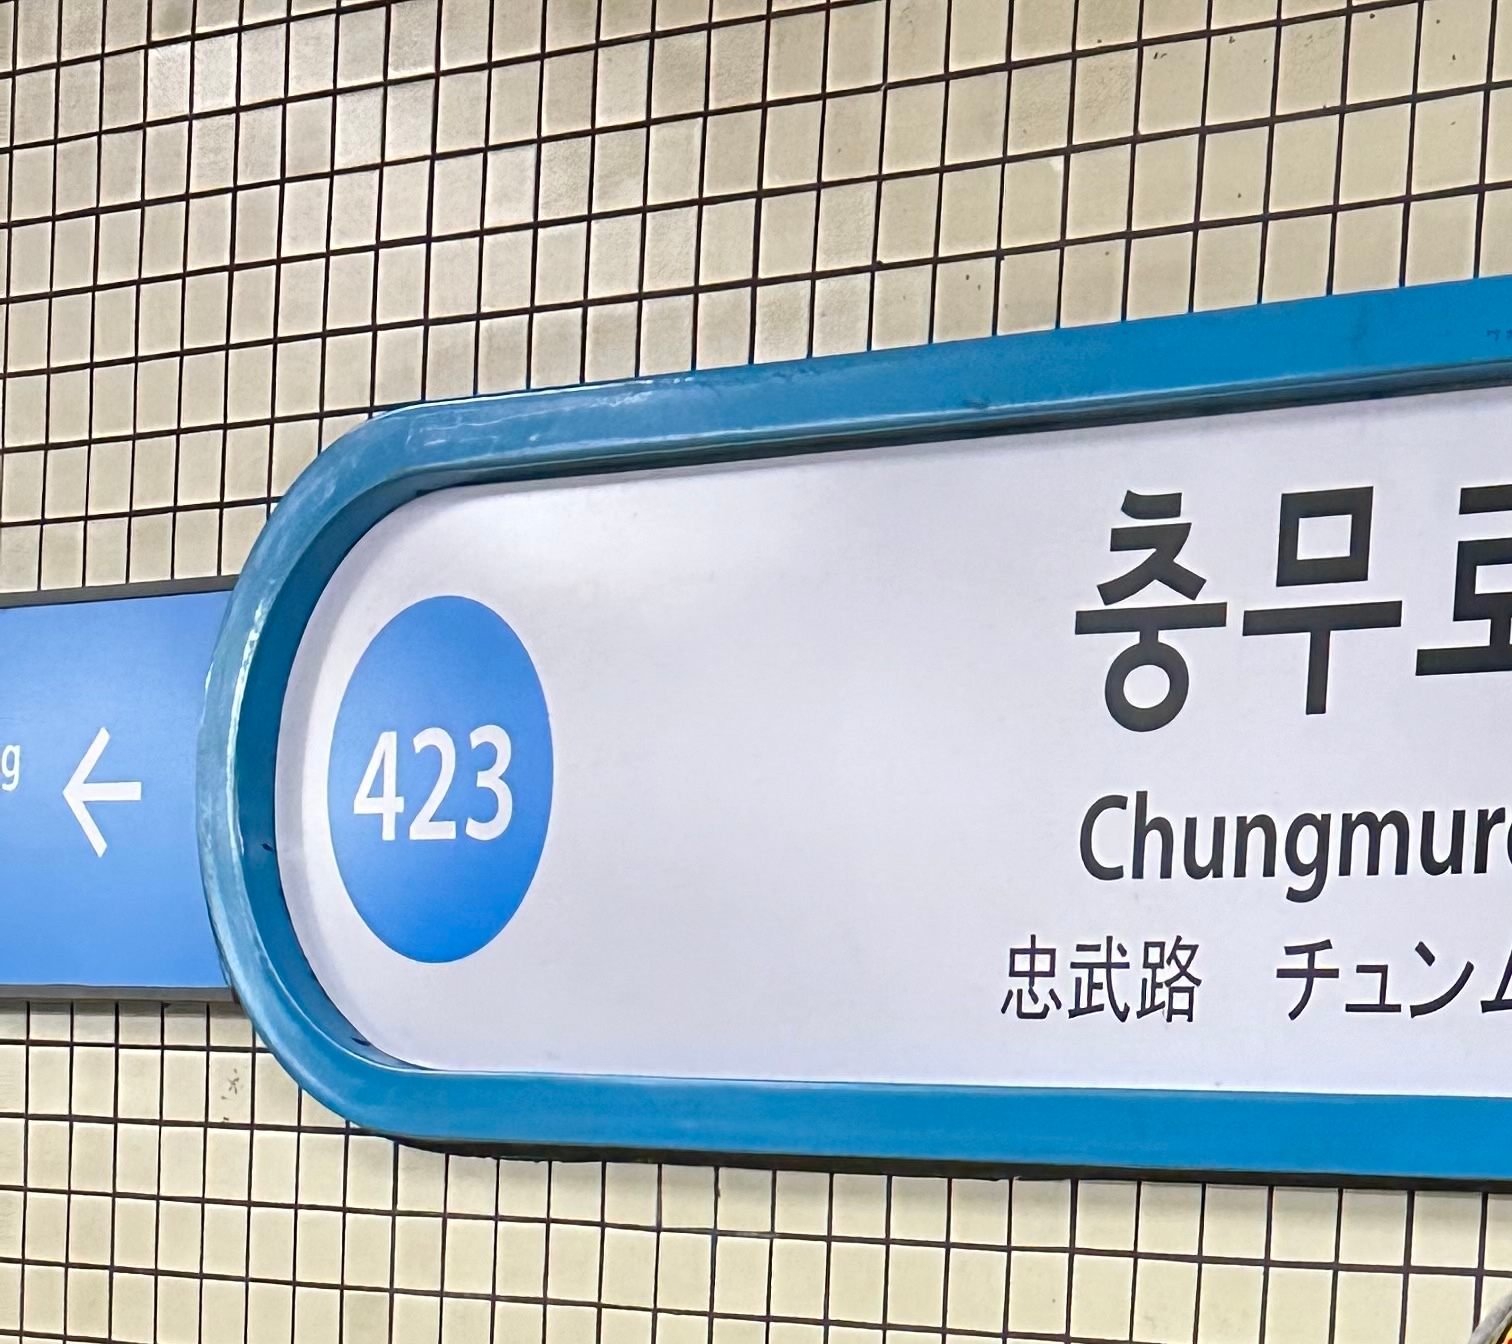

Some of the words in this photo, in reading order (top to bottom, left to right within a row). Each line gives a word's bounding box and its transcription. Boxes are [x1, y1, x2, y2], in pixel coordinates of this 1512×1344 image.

[353, 725, 513, 841] 423
[1000, 933, 1203, 1023] 忠武路
